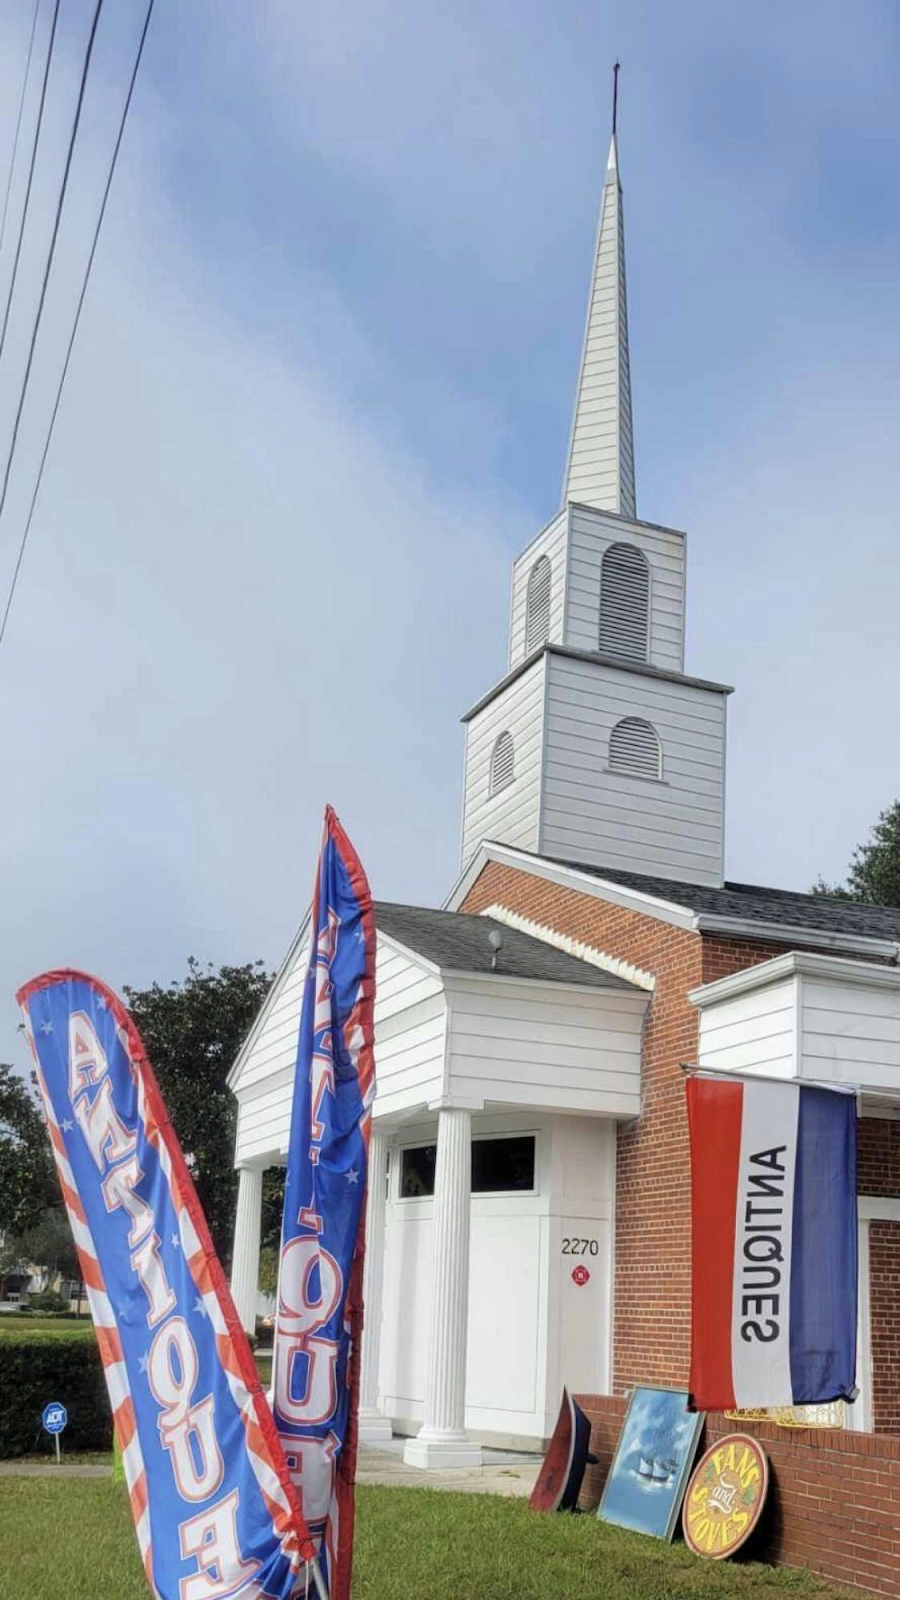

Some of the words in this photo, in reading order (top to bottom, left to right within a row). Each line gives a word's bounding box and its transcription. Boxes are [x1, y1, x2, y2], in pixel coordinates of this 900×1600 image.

[561, 1237, 599, 1256] 2270
[46, 1410, 64, 1424] ADT
[711, 1444, 760, 1488] FANS
[690, 1484, 749, 1551] STOVES
